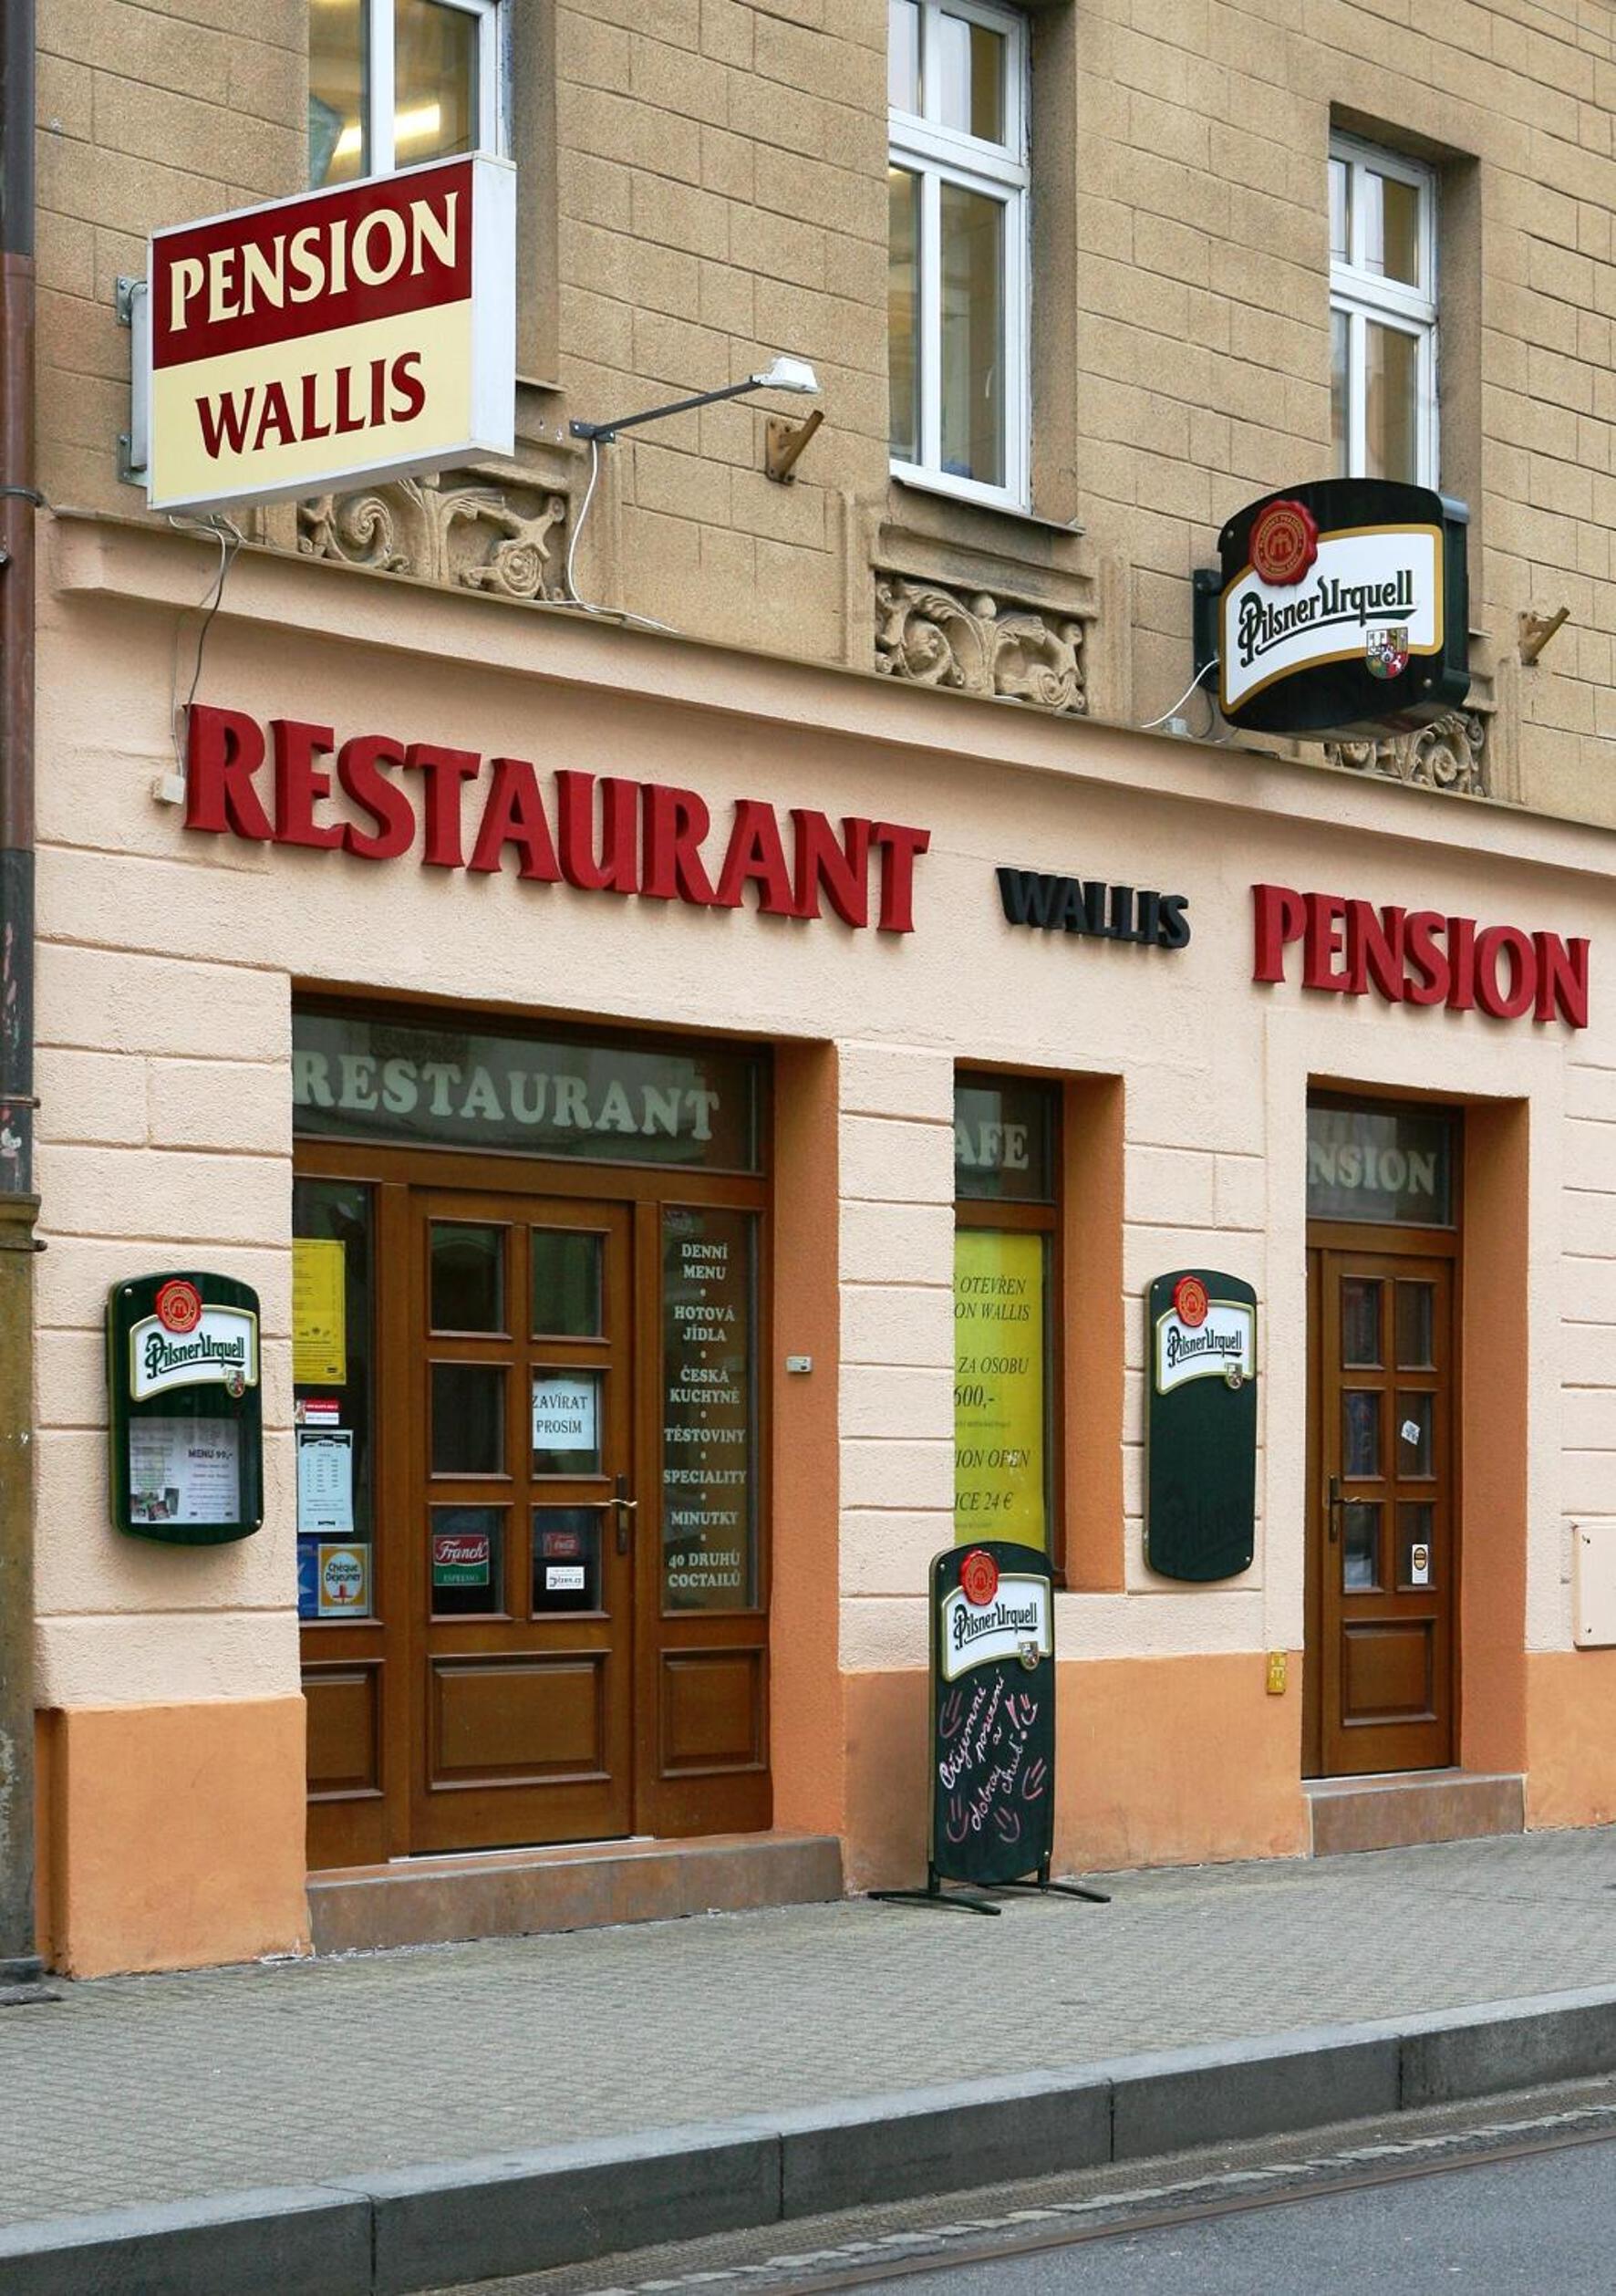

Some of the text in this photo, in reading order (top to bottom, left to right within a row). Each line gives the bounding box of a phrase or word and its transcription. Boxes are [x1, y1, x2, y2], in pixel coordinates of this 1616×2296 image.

[169, 191, 459, 333] PENSION
[195, 351, 427, 460] WALLIS
[1238, 569, 1414, 669] Pilsner Urquell
[183, 703, 932, 932] RESTAURANT
[995, 867, 1191, 949] WALLIS
[1248, 883, 1591, 1029] PENSION
[293, 1050, 720, 1141] RESTAURANT
[681, 1242, 729, 1260] DENNÍ
[683, 1264, 727, 1281] MENU
[674, 1304, 735, 1322] HOTOVÁ
[982, 1303, 1031, 1321] WALLIS
[682, 1325, 727, 1342] JÍDLA
[145, 1331, 201, 1380] Pilsner
[199, 1331, 245, 1368] Urquell
[1167, 1325, 1243, 1368] Pilsner Urquell
[680, 1365, 730, 1383] ČESKÁ
[958, 1356, 1030, 1374] ZA OSOBU
[532, 1392, 589, 1409] ZAVÍRAT
[536, 1417, 583, 1434] PROSÍM
[188, 1449, 214, 1460] MENU
[988, 1449, 1031, 1469] OPEN
[663, 1470, 747, 1485] SPECIALITY
[983, 1491, 1000, 1511] 24
[670, 1511, 740, 1527] MINUTKY
[668, 1553, 686, 1569] 40
[954, 1601, 1038, 1651] Pilsner Urquell
